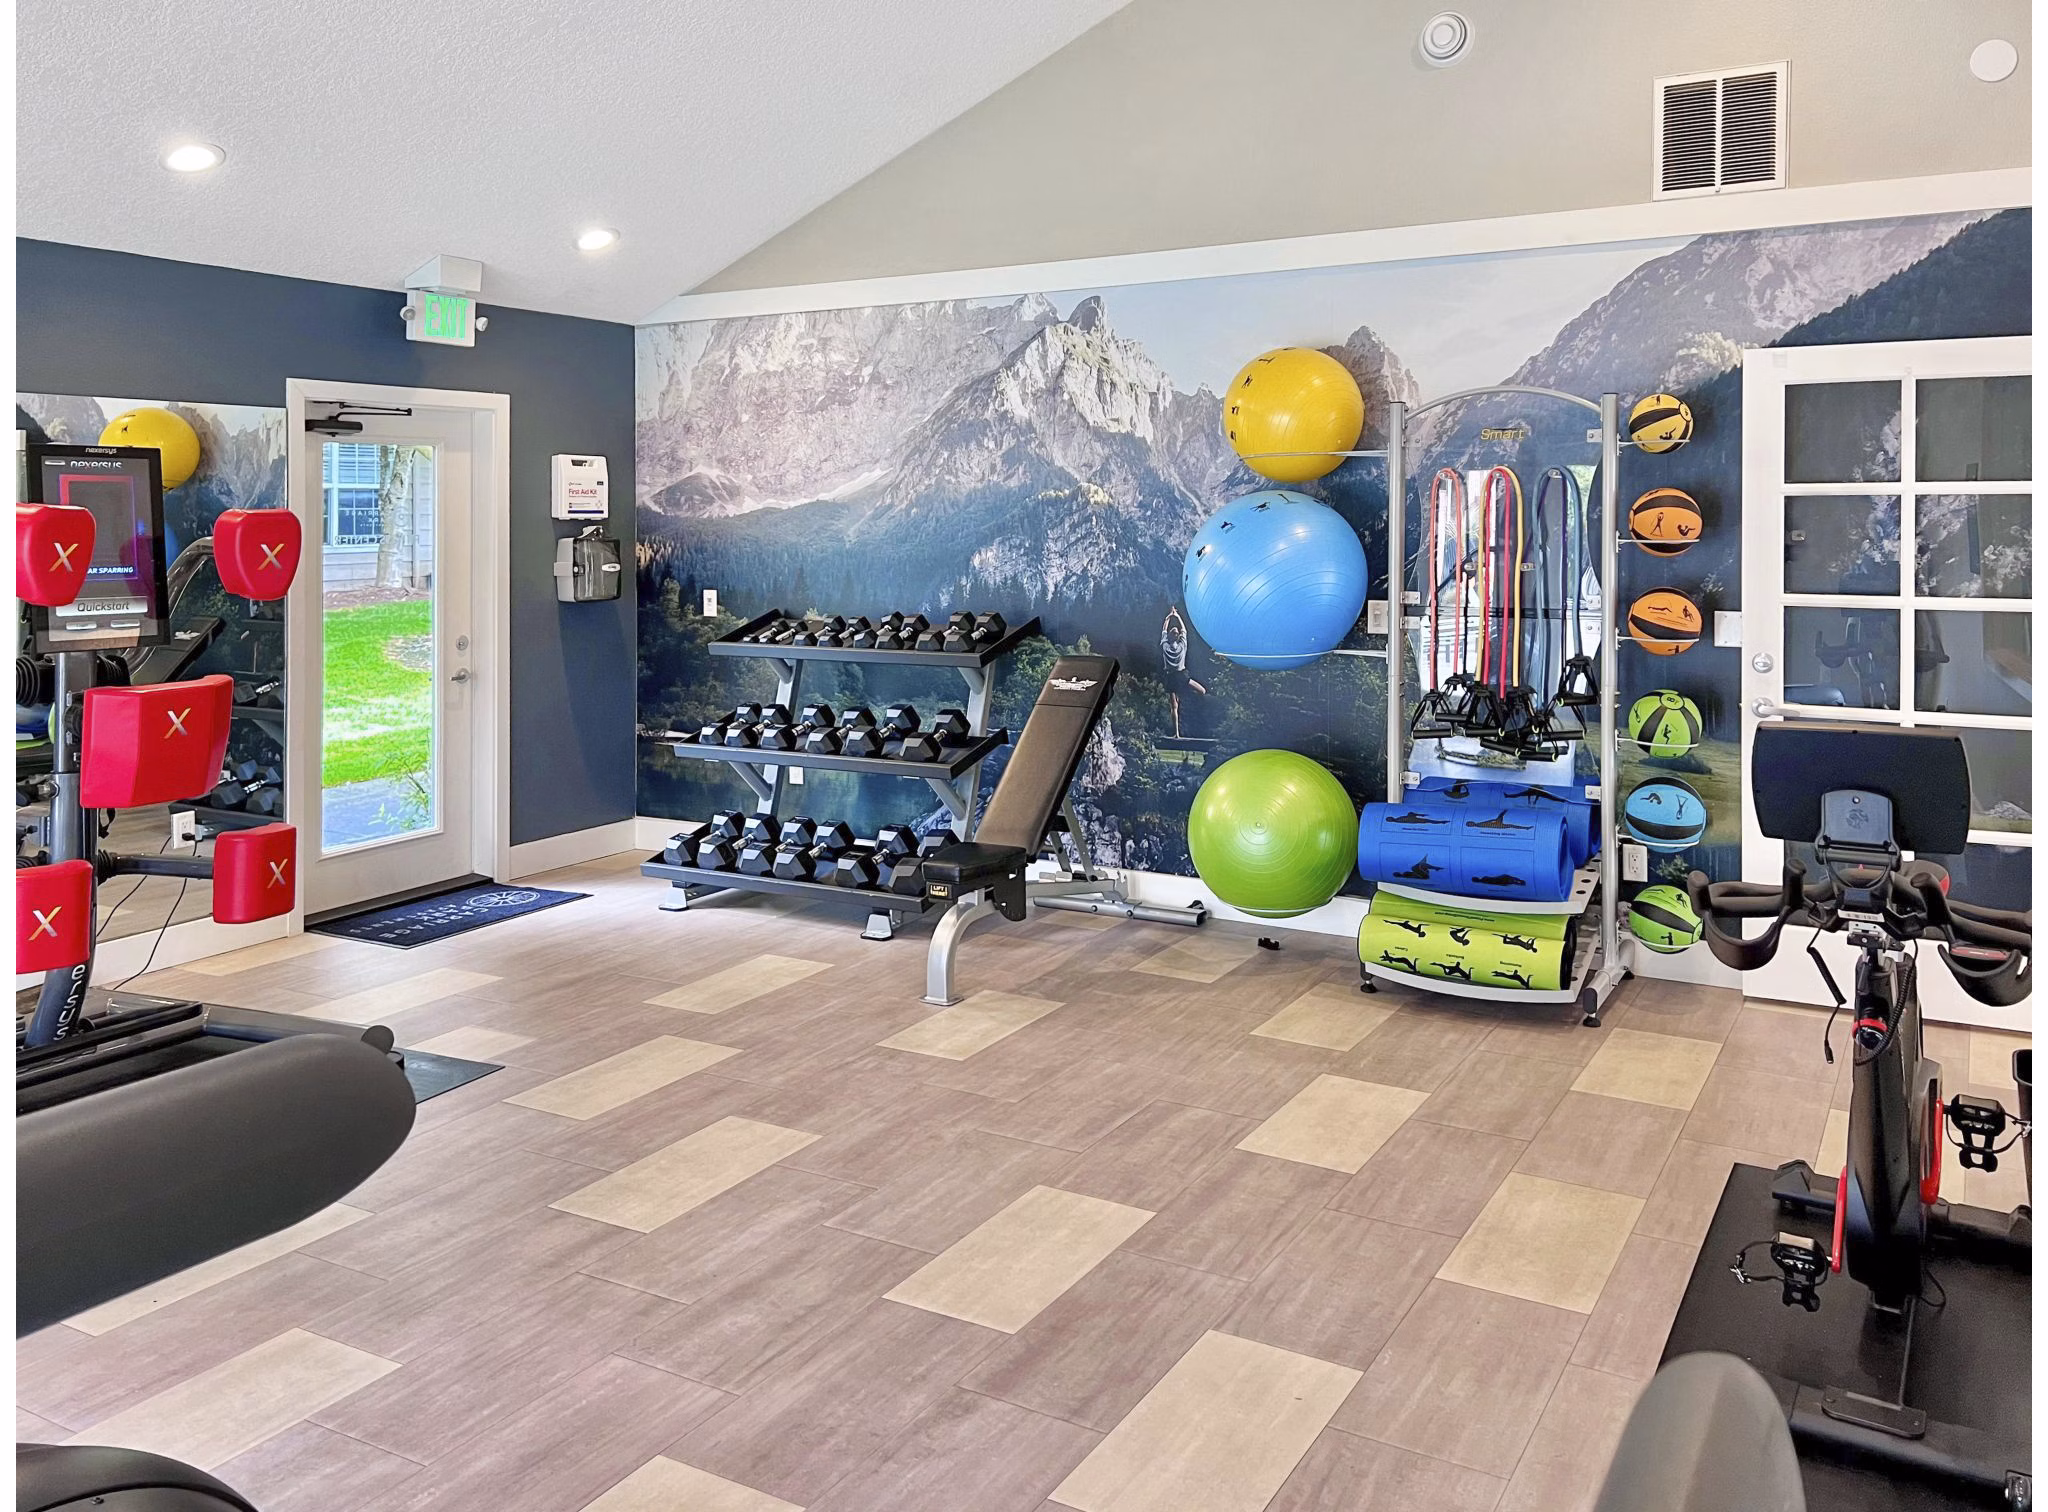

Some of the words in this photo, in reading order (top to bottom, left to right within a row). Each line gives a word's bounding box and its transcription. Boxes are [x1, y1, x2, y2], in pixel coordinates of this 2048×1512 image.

[424, 294, 468, 338] EXIT
[1481, 429, 1525, 440] Smart
[85, 447, 117, 455] nexersys
[99, 566, 134, 574] SPARRING
[77, 601, 129, 612] Quickstart
[53, 964, 86, 1040] ersys
